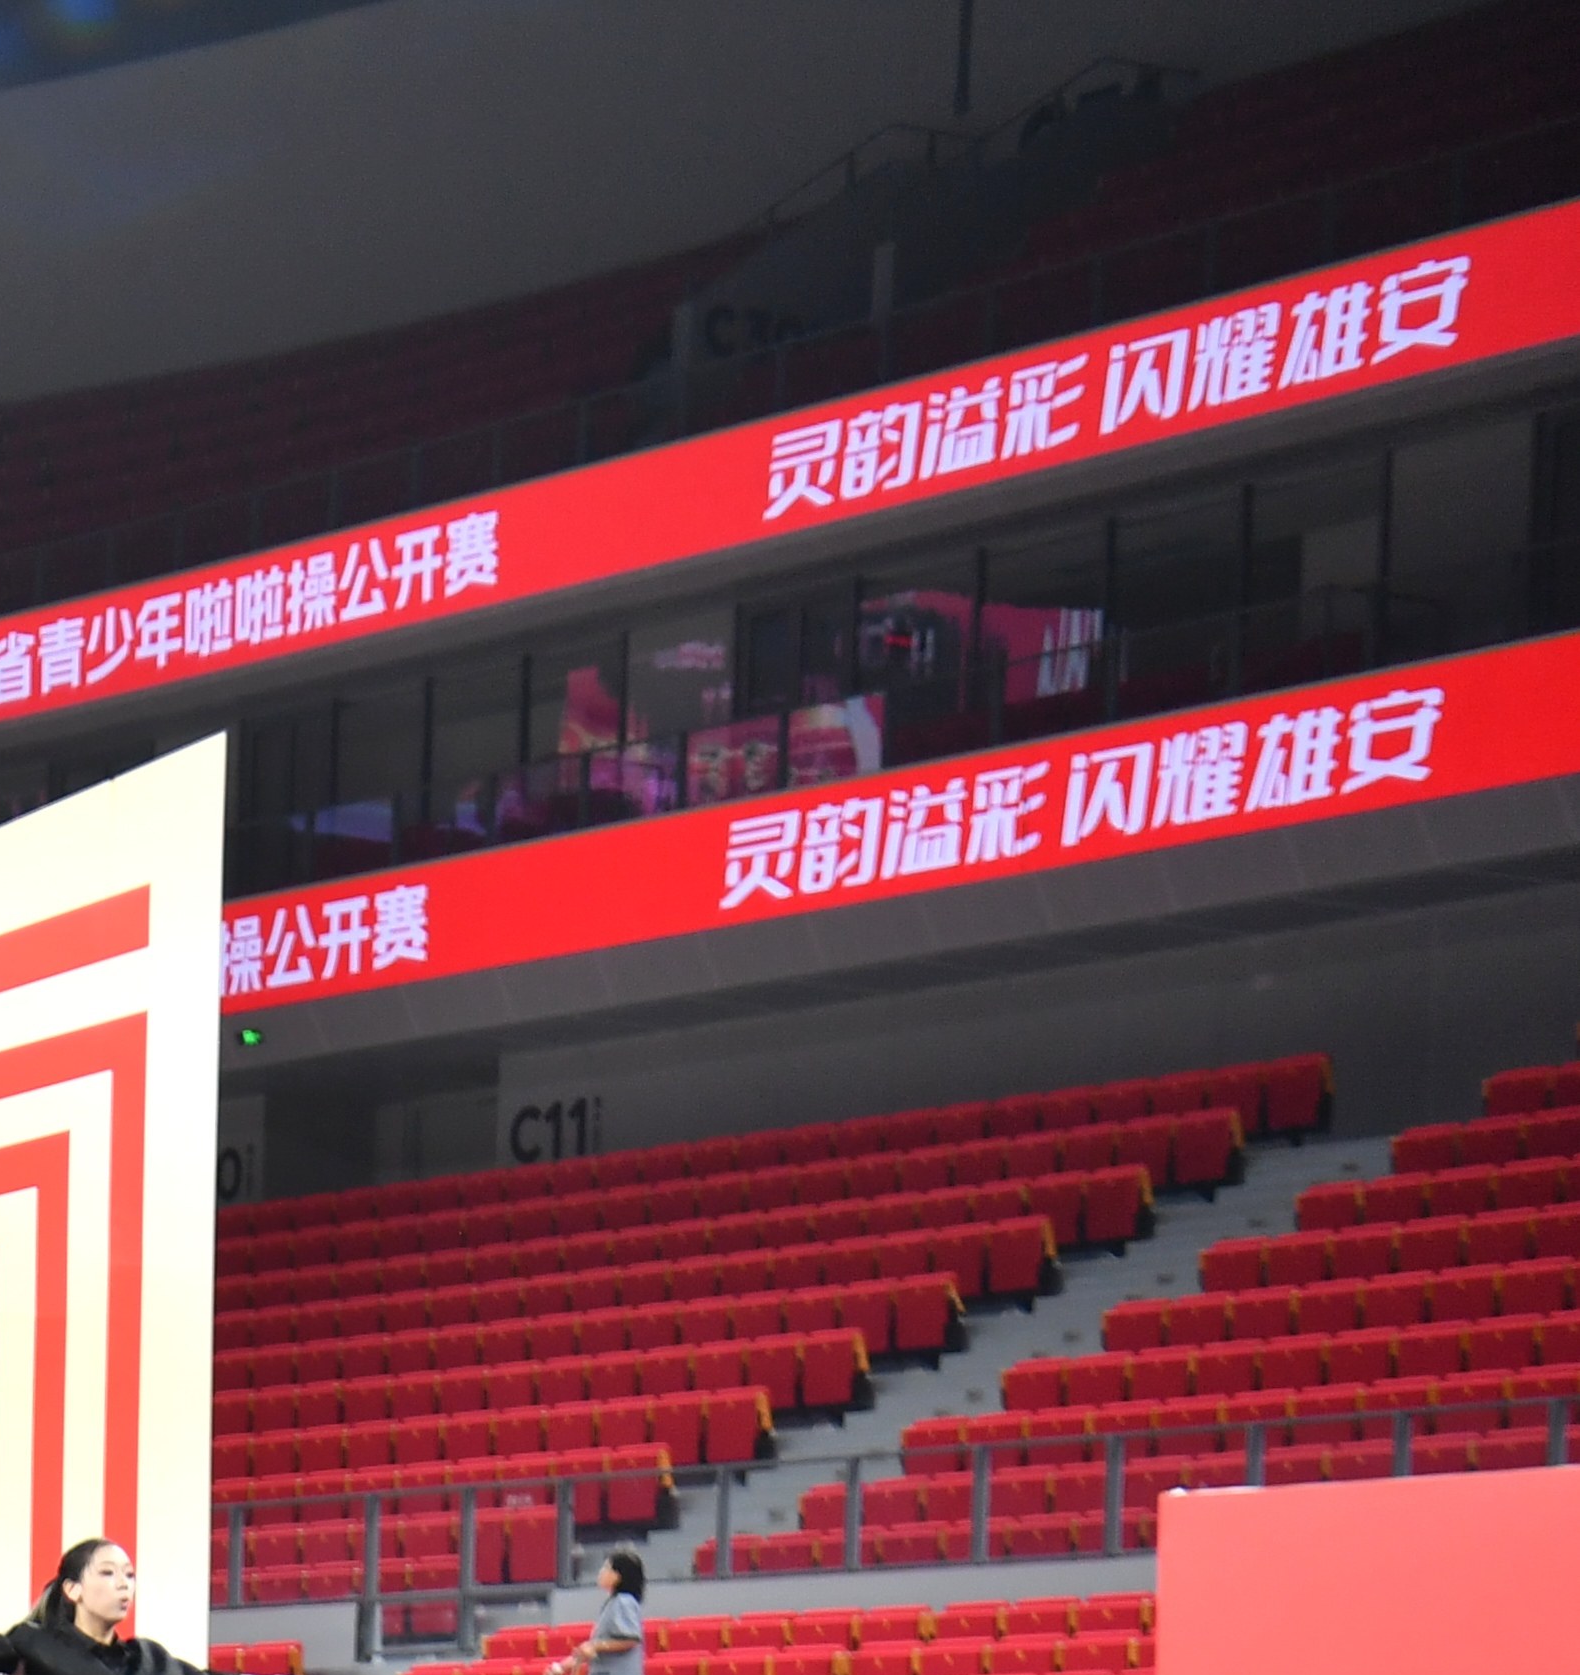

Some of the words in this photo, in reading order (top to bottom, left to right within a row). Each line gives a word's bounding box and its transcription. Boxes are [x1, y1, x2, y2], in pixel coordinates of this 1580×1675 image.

[762, 354, 1089, 521] 灵韵溢彩
[1099, 255, 1472, 436] 闪耀雄安
[718, 761, 1050, 910] 灵韵溢彩
[1060, 687, 1445, 847] 闪耀雄安
[508, 1096, 590, 1164] C11
